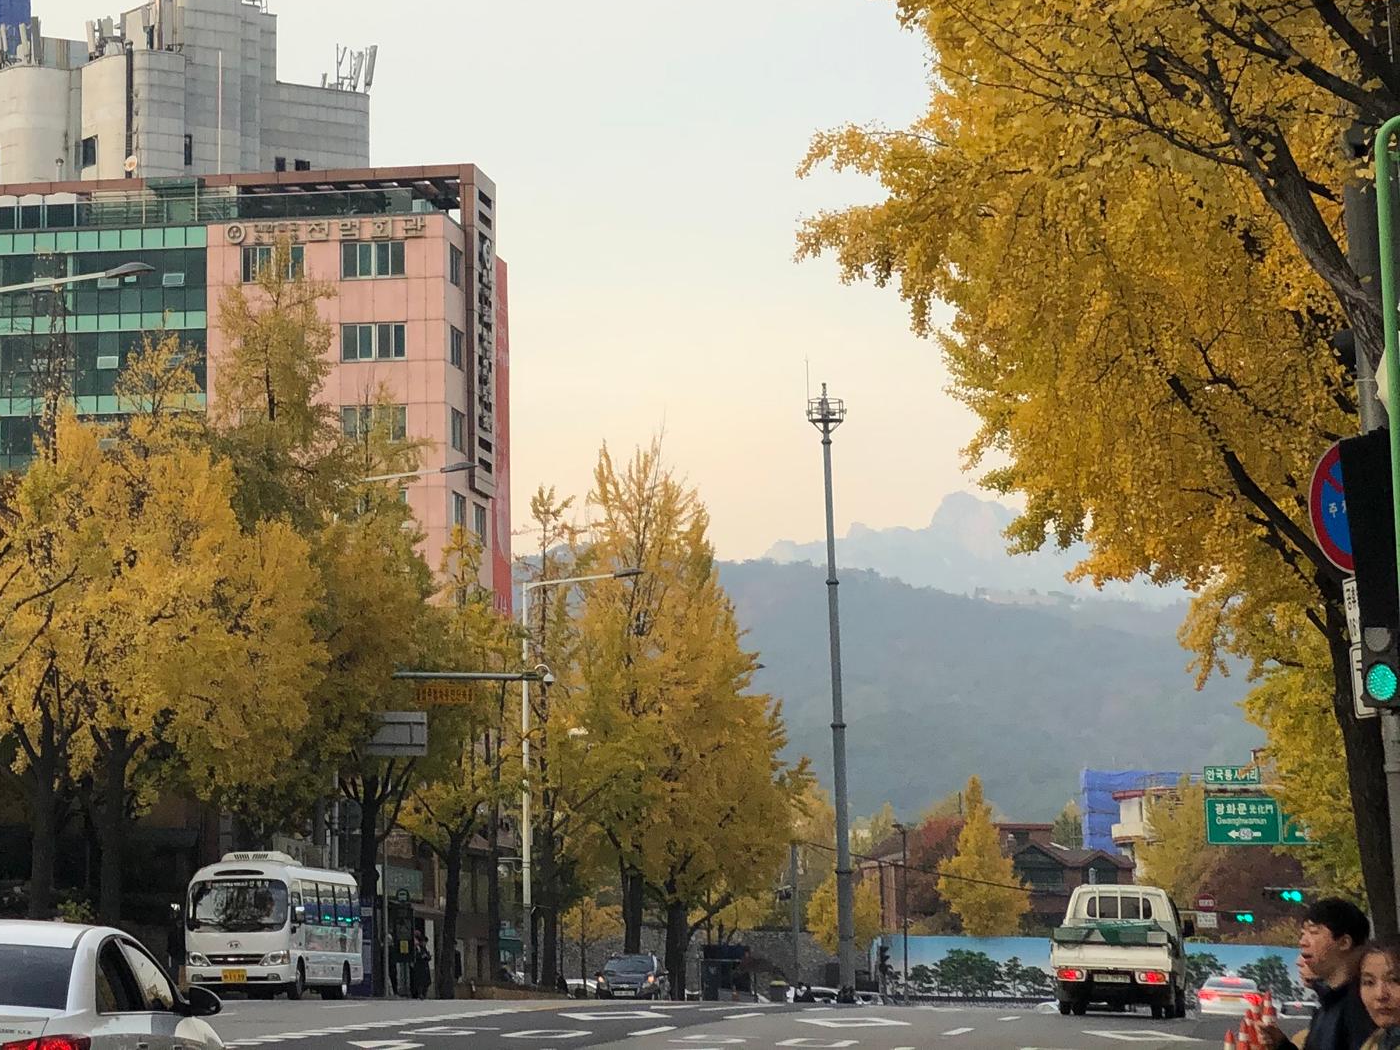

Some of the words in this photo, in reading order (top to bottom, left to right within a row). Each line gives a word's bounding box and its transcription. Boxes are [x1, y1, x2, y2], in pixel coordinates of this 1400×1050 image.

[307, 216, 426, 242] 전법회관
[1215, 803, 1247, 815] 광화문
[1215, 816, 1267, 827] Gwanghwamun
